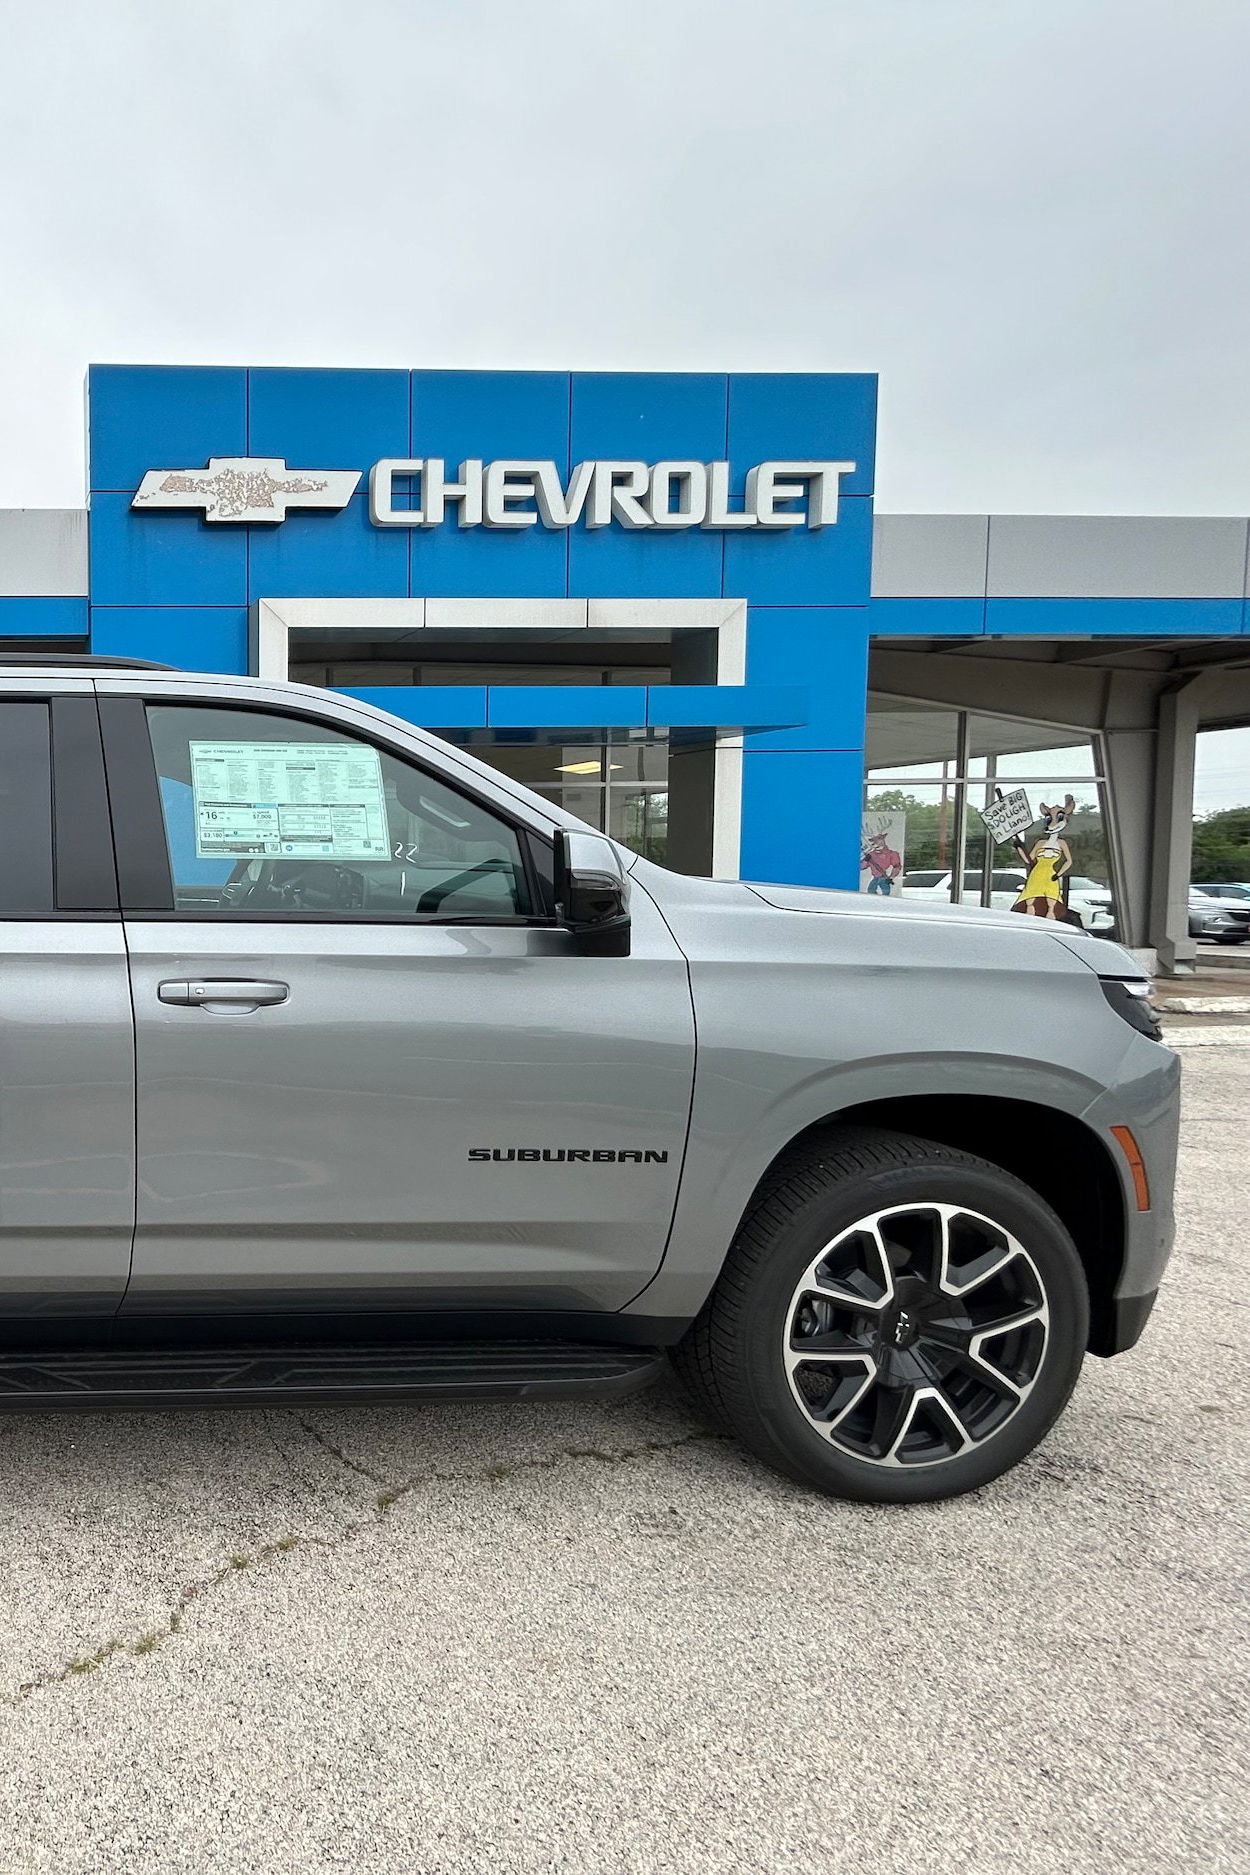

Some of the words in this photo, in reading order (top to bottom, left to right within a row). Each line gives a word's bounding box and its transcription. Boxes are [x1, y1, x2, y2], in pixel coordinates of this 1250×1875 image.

[369, 458, 856, 529] CHEVROLET
[206, 811, 218, 820] 16
[984, 803, 1007, 821] Save
[1008, 792, 1023, 806] BIG
[1002, 811, 1029, 833] Llano!
[468, 1148, 668, 1163] SUBURBAN
